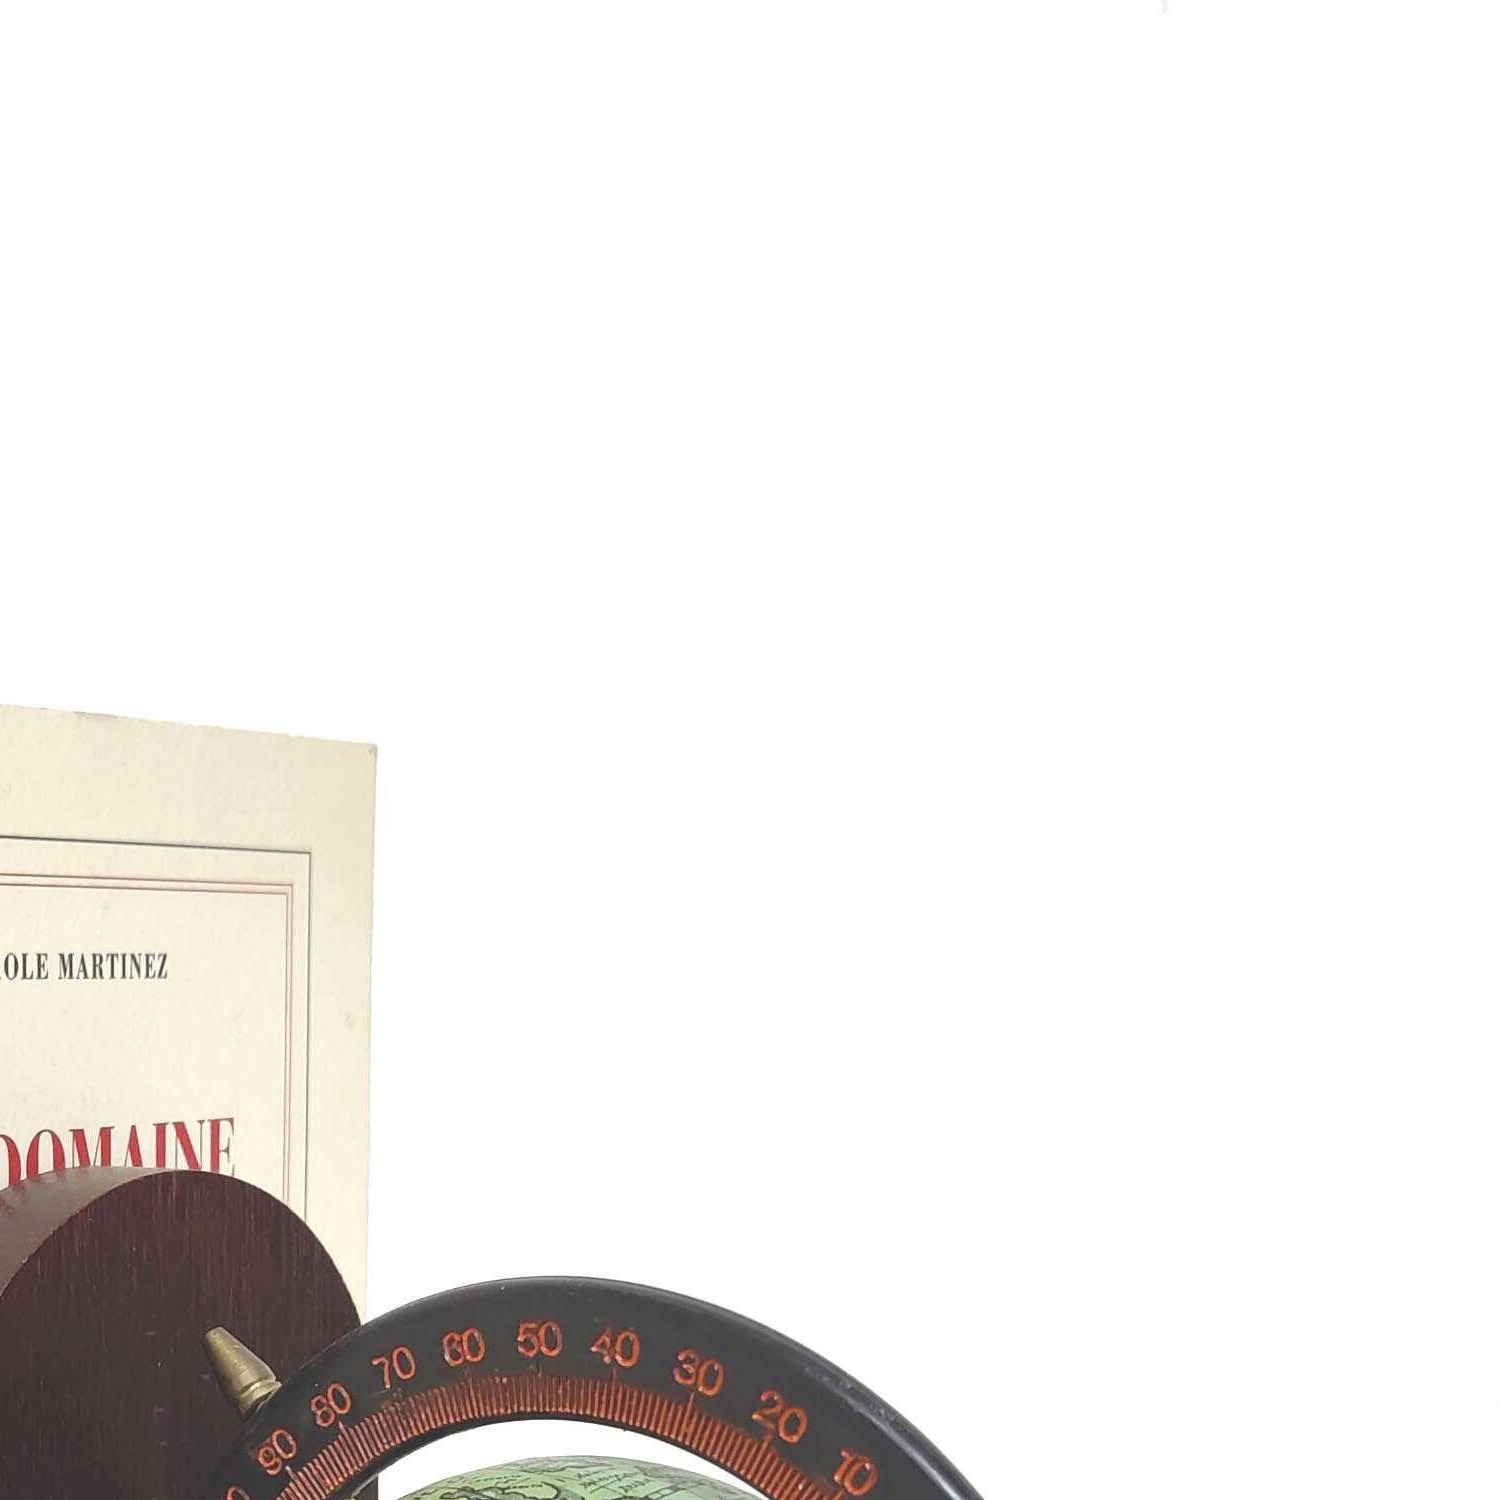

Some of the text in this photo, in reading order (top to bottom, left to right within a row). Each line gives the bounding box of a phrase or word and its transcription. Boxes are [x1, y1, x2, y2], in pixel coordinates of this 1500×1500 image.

[58, 952, 169, 980] MARTINEZ
[442, 1327, 486, 1368] 60
[516, 1320, 563, 1357] 50
[591, 1329, 640, 1367] 40
[373, 1346, 416, 1388] 70
[673, 1349, 724, 1396] 30
[310, 1382, 352, 1428] 80
[752, 1390, 808, 1443] 20
[257, 1427, 297, 1476] 90
[834, 1448, 878, 1496] 10
